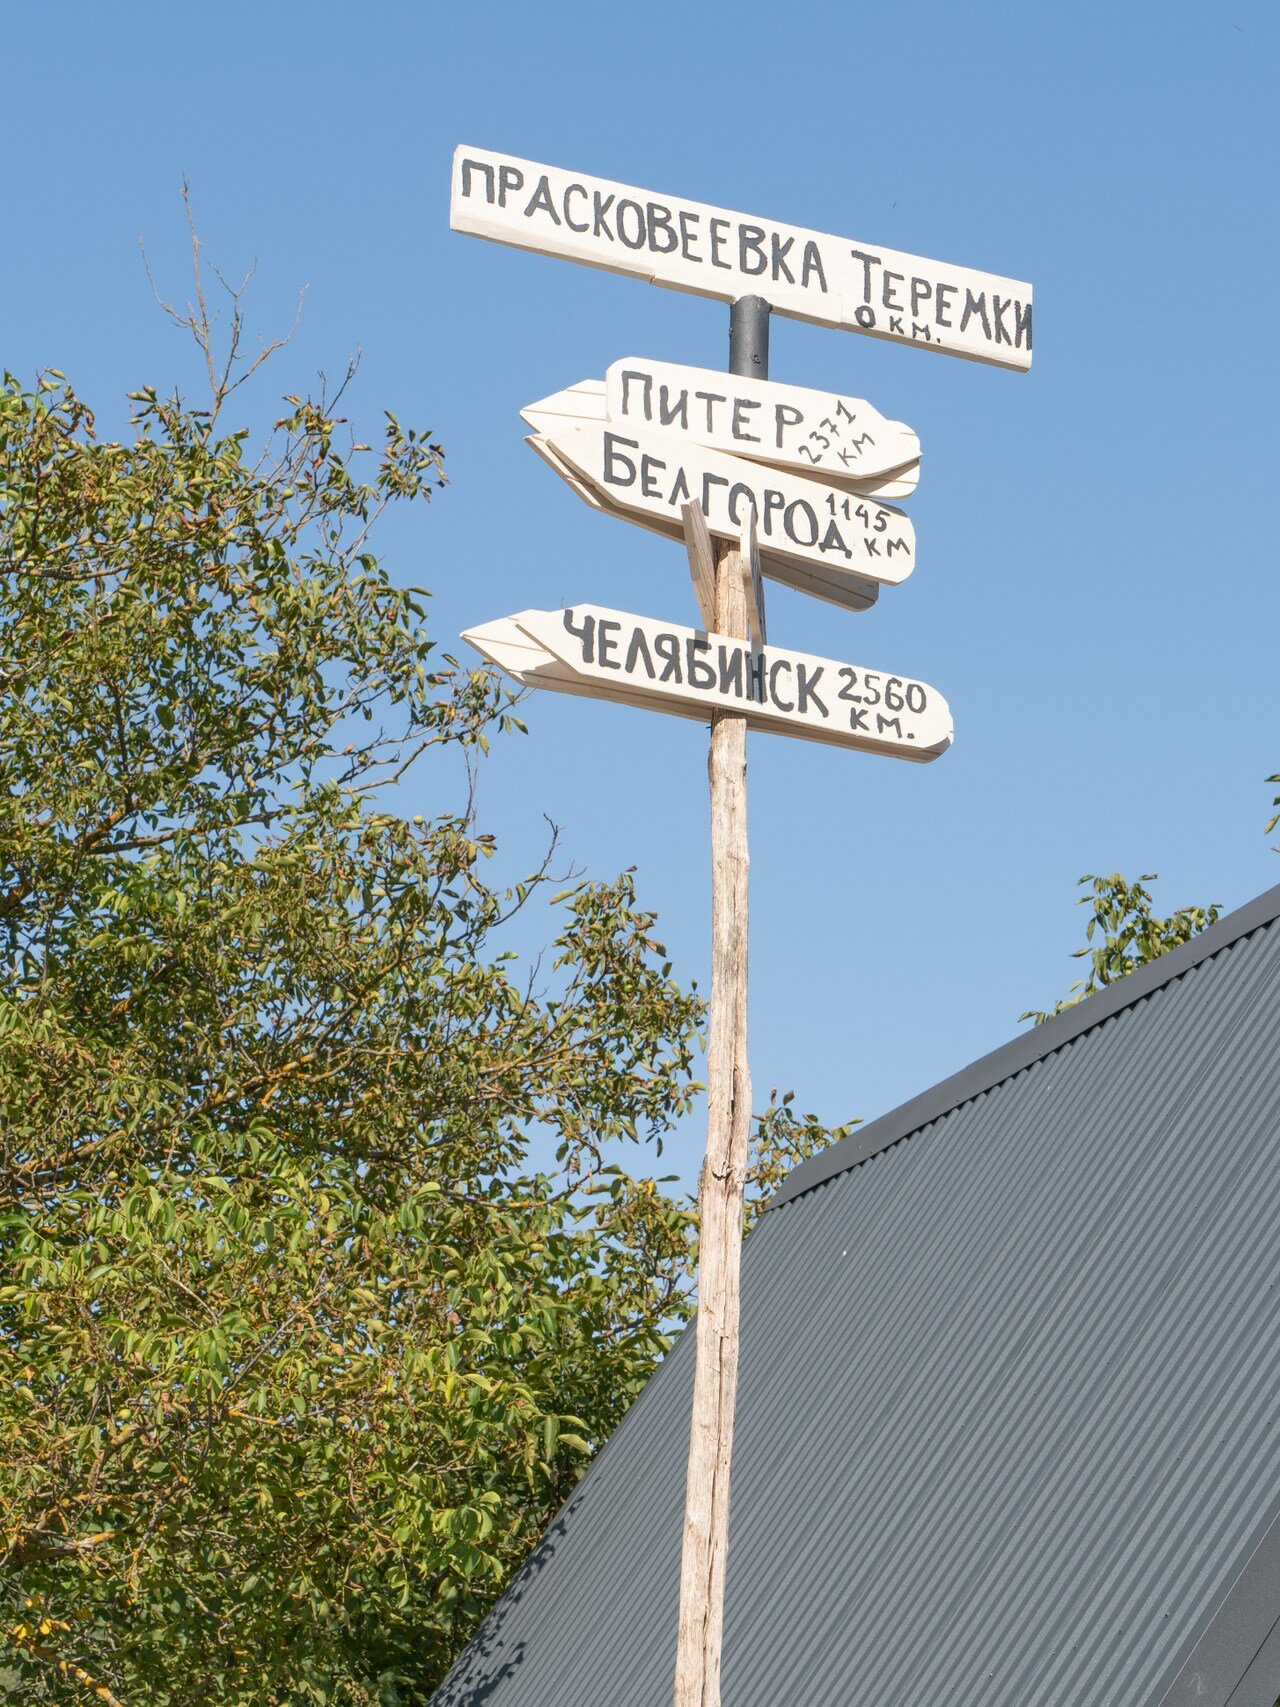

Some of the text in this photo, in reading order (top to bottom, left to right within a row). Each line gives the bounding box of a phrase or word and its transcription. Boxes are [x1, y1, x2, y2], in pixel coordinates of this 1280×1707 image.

[461, 158, 1033, 350] ПРАСКОВЕЕВКА ТЕРЕМКИ
[621, 370, 804, 449] ПИТЕР
[798, 399, 857, 465] 2371
[603, 431, 852, 559] БЕЛГОРОД
[826, 492, 892, 533] 1145
[563, 608, 829, 719] ЧЕЛЯБИНСК
[836, 667, 927, 714] 2560
